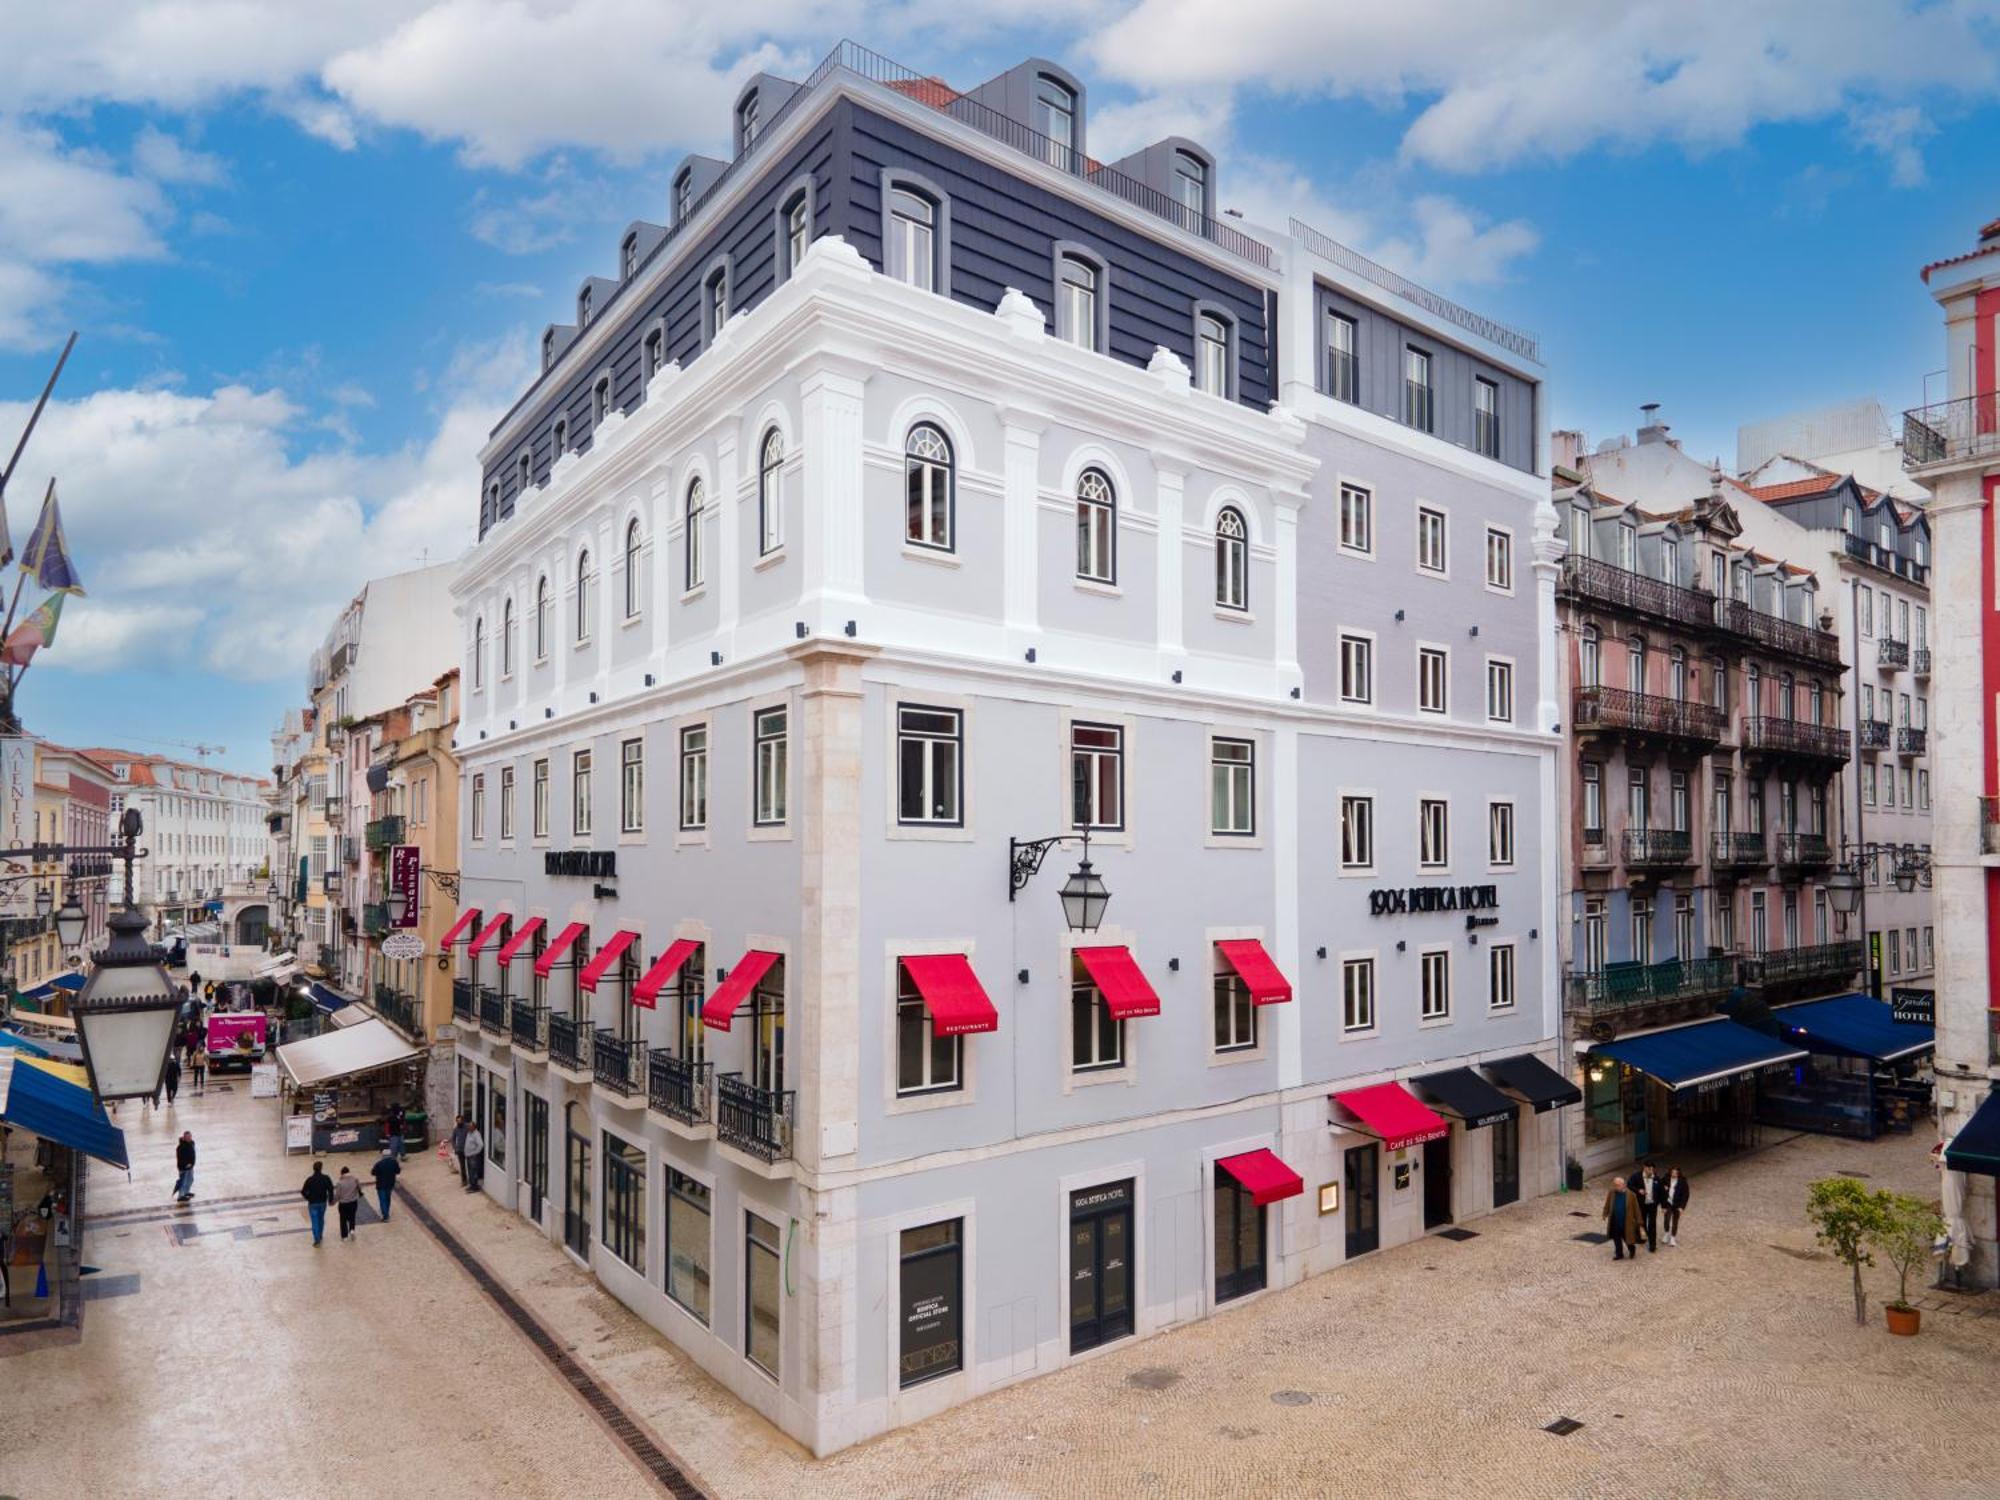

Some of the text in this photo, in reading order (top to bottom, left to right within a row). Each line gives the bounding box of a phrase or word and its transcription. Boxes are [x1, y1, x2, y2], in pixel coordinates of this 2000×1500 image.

[1369, 888, 1406, 915] 1904
[1459, 885, 1500, 910] HOTEL
[1894, 1011, 1934, 1022] HOTEL
[946, 1023, 989, 1031] RESTAURANTE
[1390, 1138, 1405, 1150] CAFÉ
[1414, 1133, 1426, 1144] SÃO
[1427, 1129, 1447, 1141] BENTO
